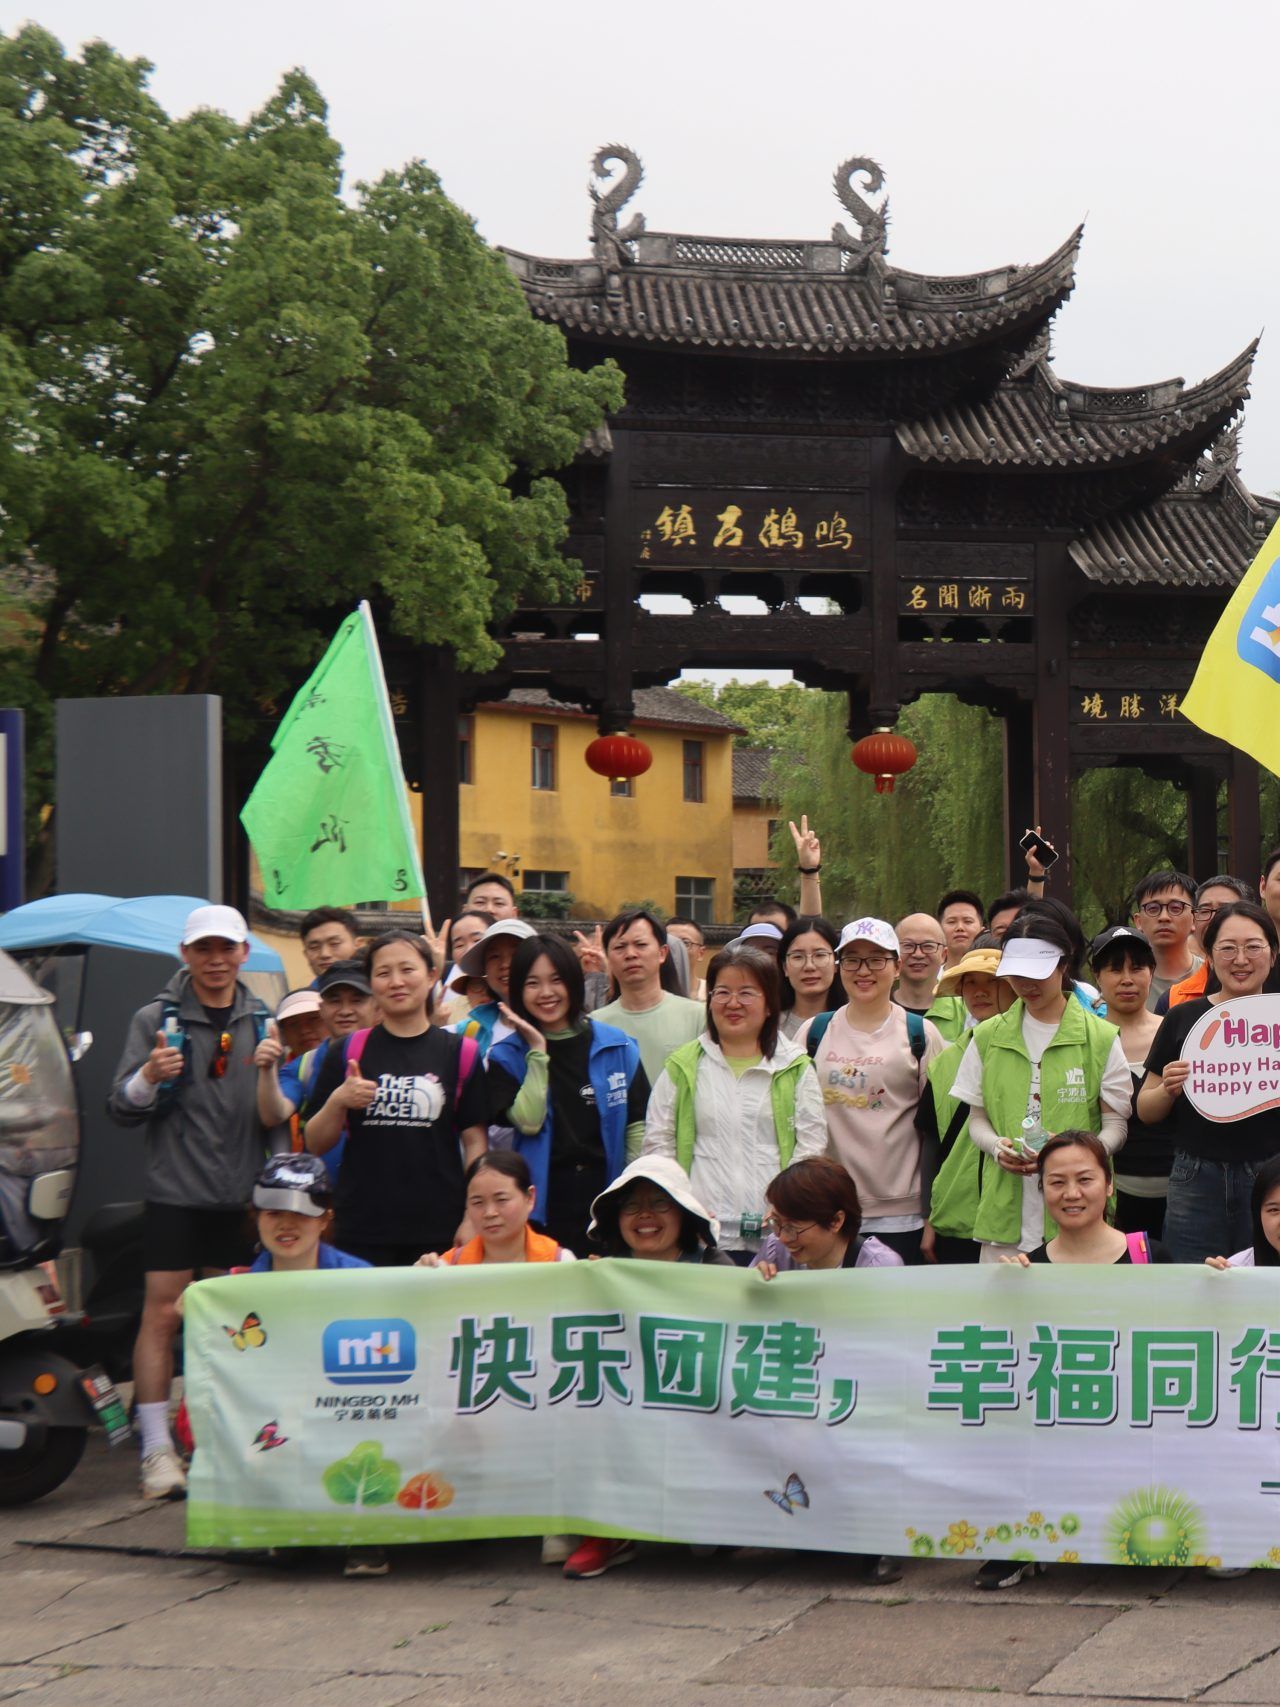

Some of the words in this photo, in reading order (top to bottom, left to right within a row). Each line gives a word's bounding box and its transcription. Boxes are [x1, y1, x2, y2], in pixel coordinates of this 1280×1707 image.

[1192, 1060, 1252, 1076] Happy
[379, 1074, 415, 1088] THE
[1193, 1079, 1253, 1096] Happy
[366, 1101, 412, 1118] FACE
[315, 1395, 386, 1408] NINGBO
[390, 1394, 419, 1406] MH
